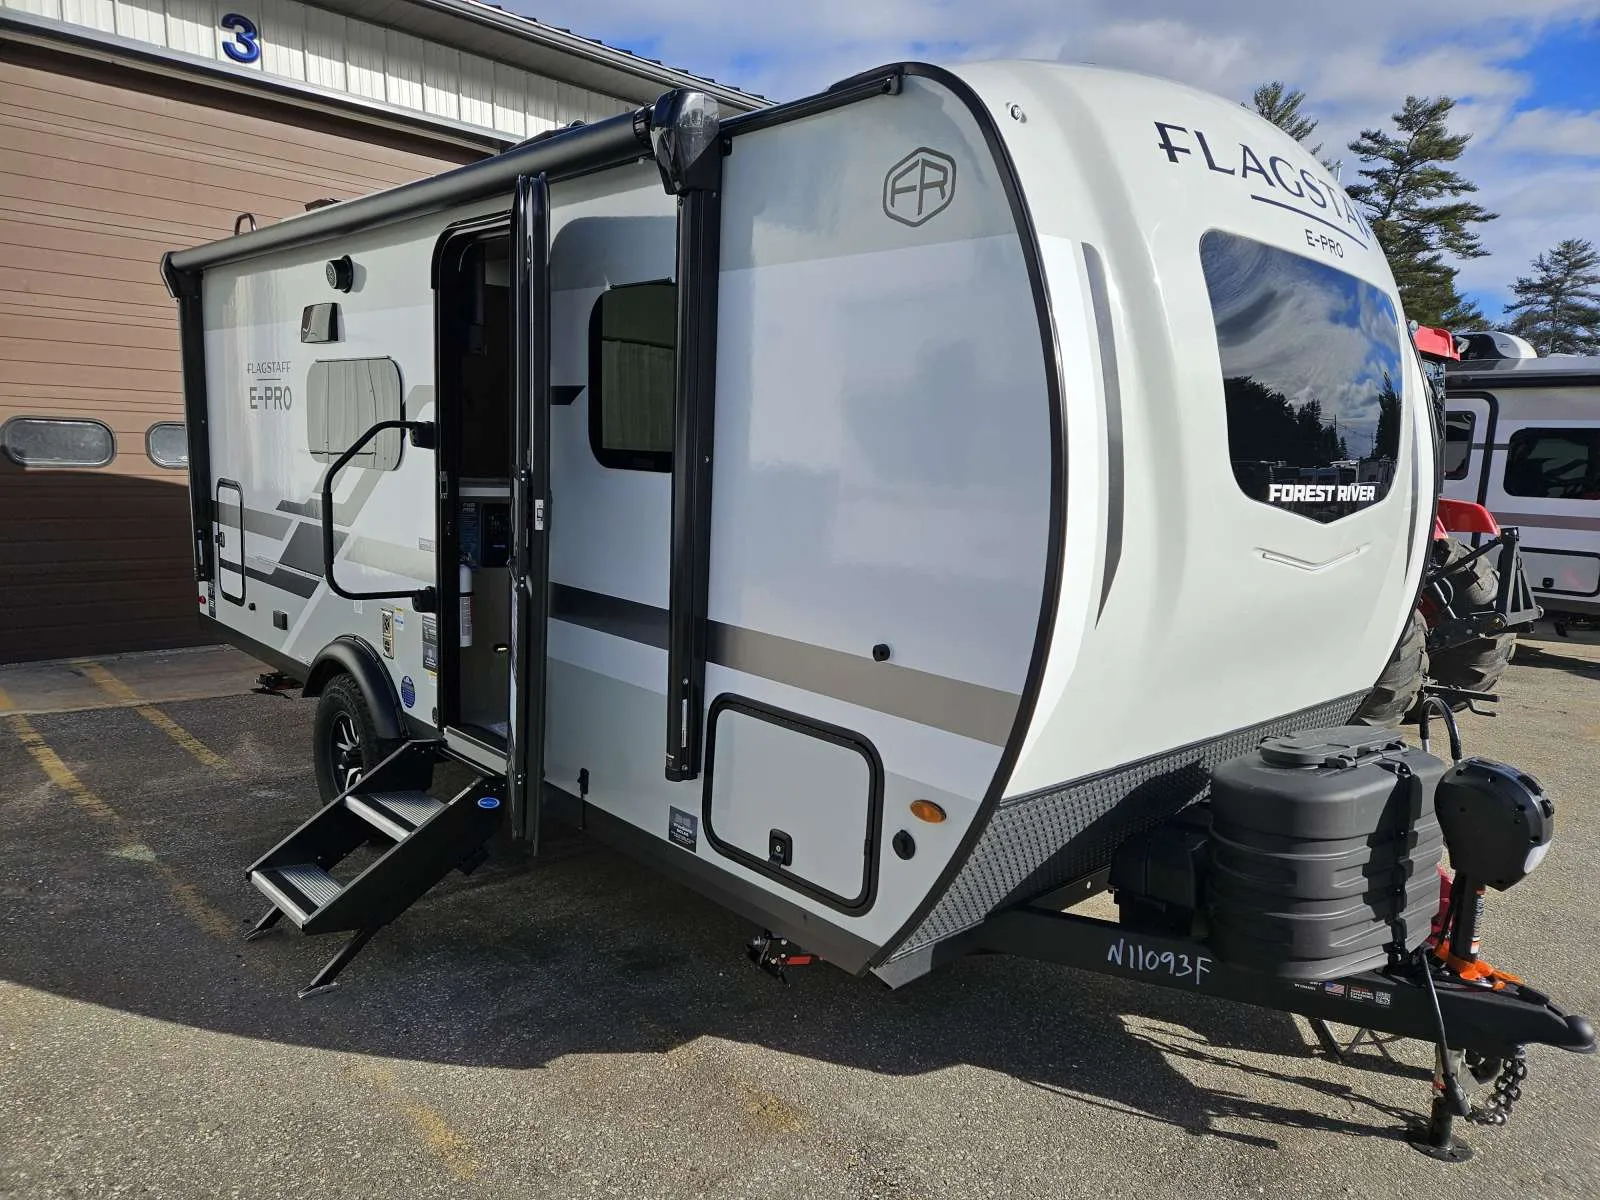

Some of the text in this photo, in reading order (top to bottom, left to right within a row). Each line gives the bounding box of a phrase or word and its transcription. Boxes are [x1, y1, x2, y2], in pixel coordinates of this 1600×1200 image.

[221, 13, 259, 63] 3
[1305, 229, 1344, 258] E-PRO
[247, 361, 291, 374] FLAGSTAFF
[249, 386, 292, 410] E-PRO
[1268, 484, 1376, 502] FOREST RIVER
[1107, 938, 1212, 985] N11093F
